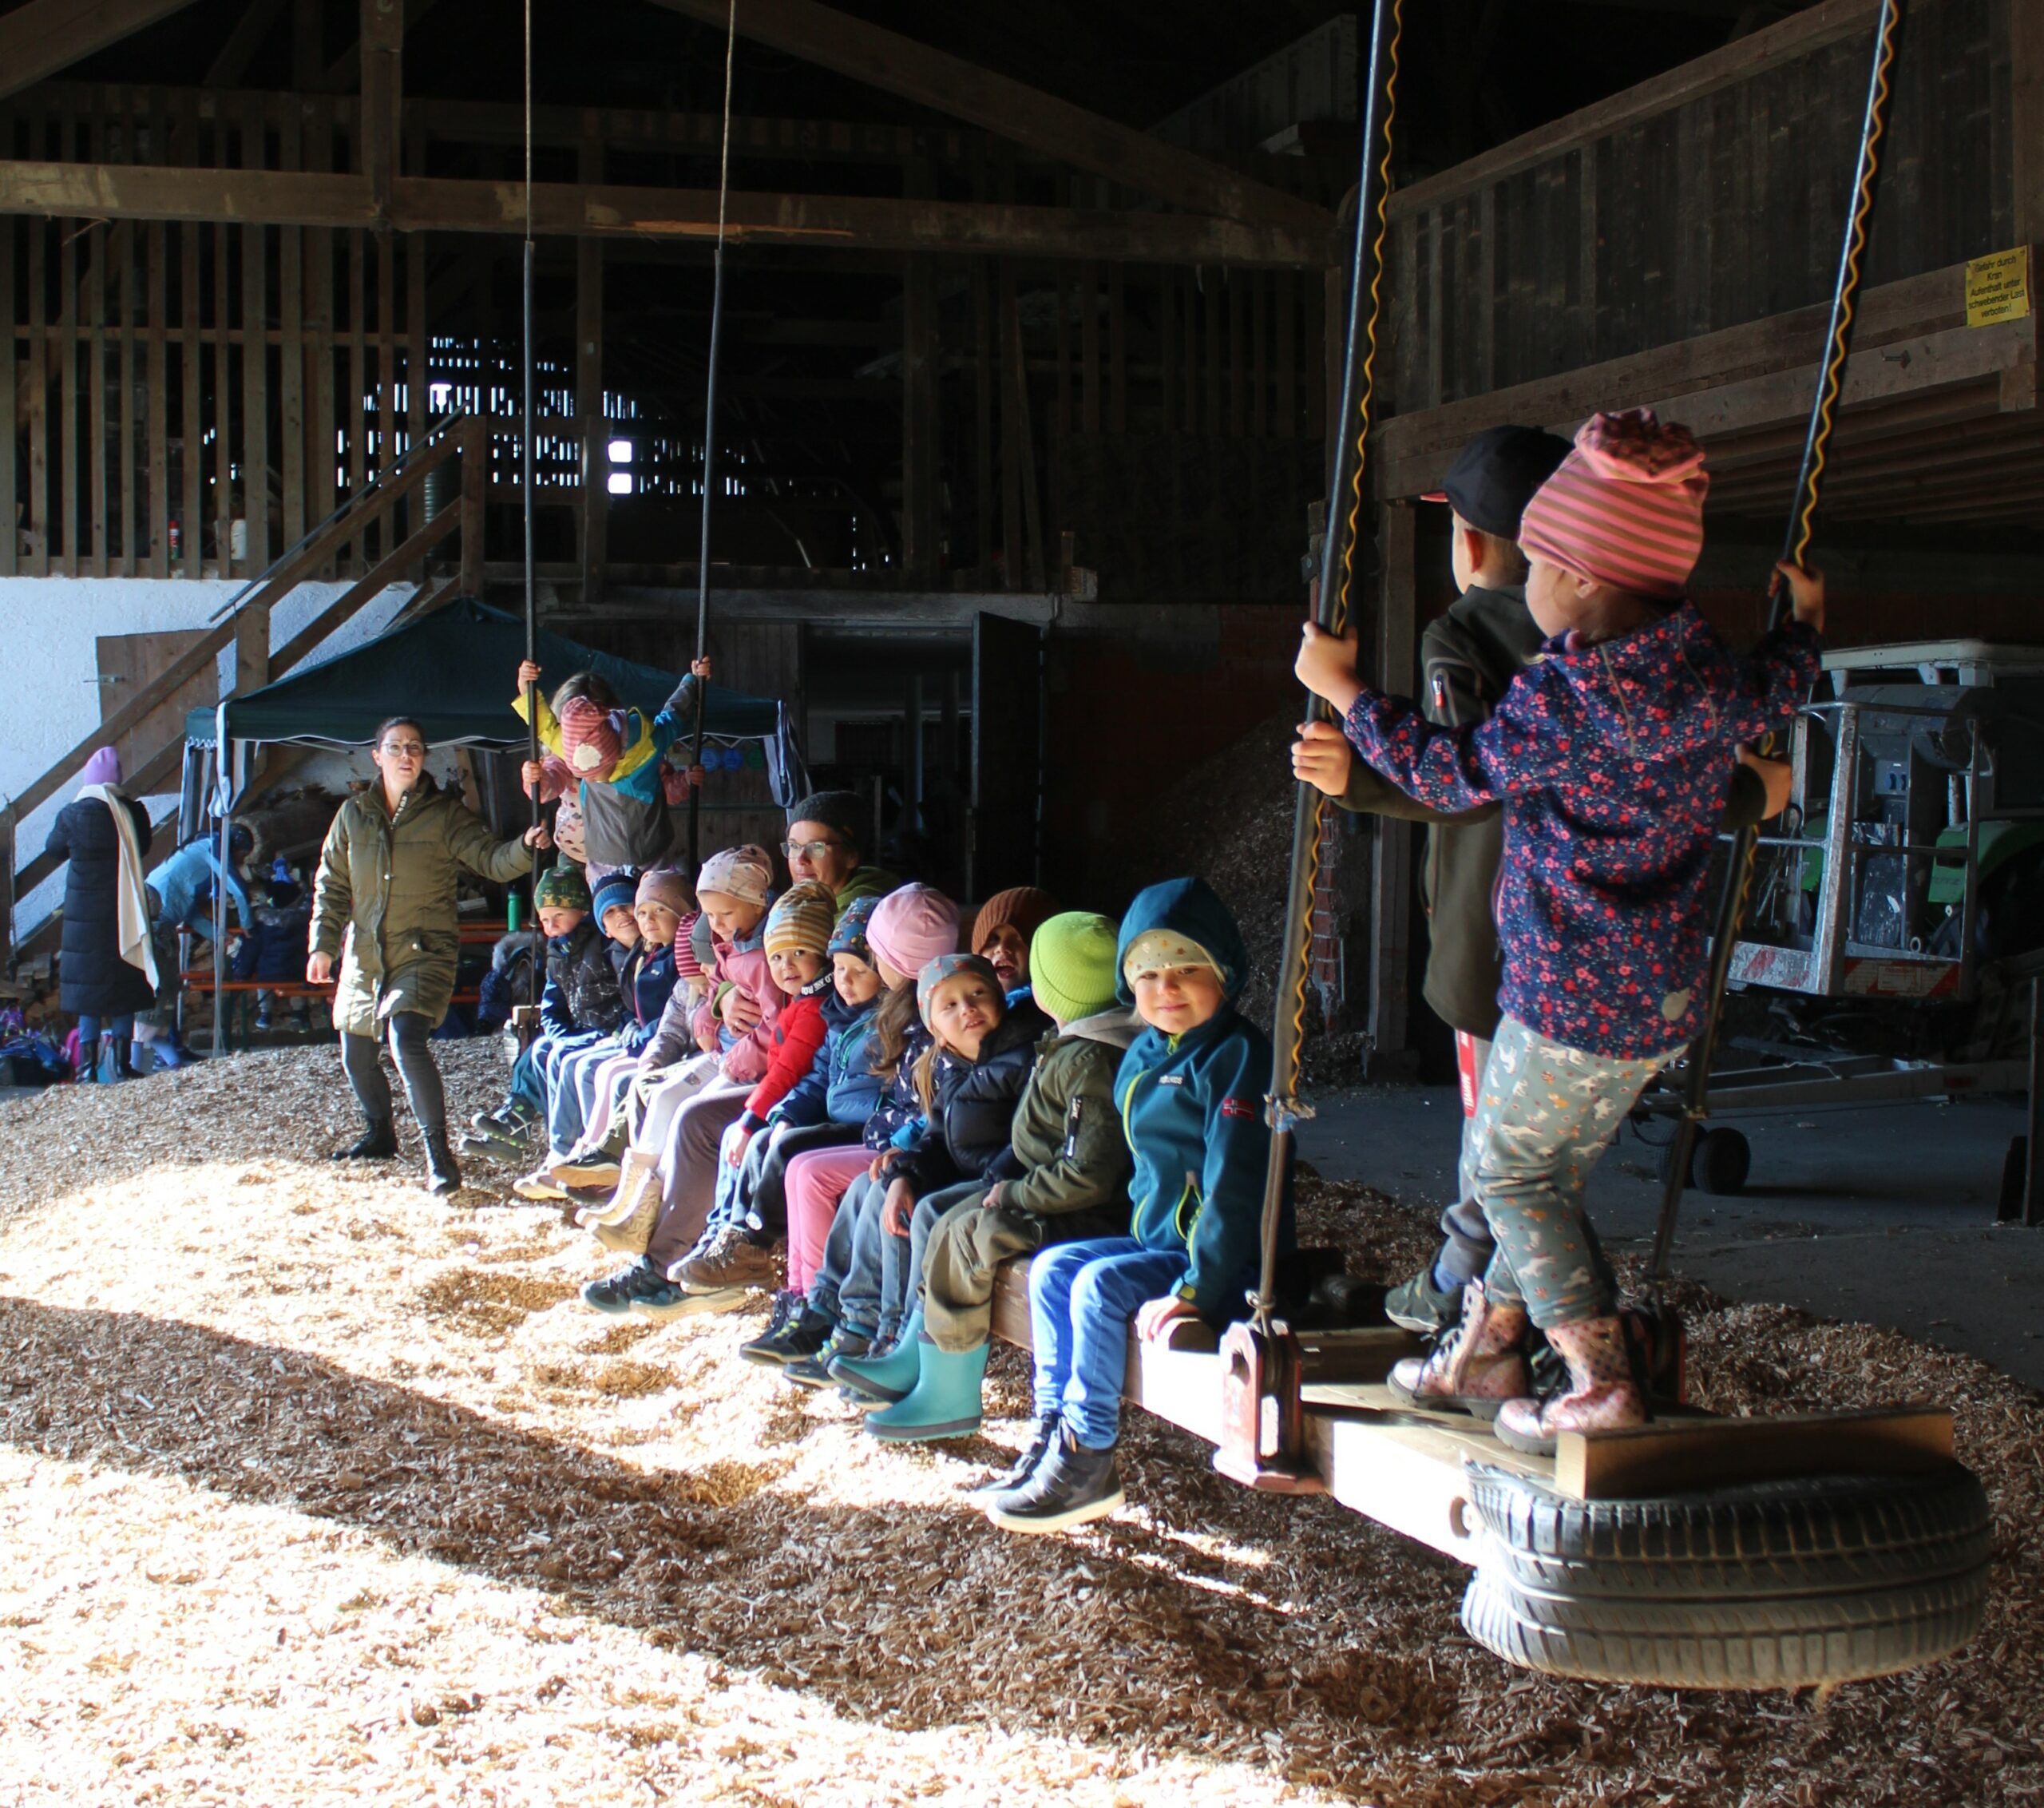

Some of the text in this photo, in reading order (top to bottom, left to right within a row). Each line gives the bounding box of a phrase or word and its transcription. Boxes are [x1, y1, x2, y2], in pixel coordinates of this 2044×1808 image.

[1997, 256, 2016, 267] durch
[1987, 272, 2002, 281] Kran
[1971, 278, 2021, 296] Aufenthalt unter
[1968, 288, 2025, 309] schwebender Last
